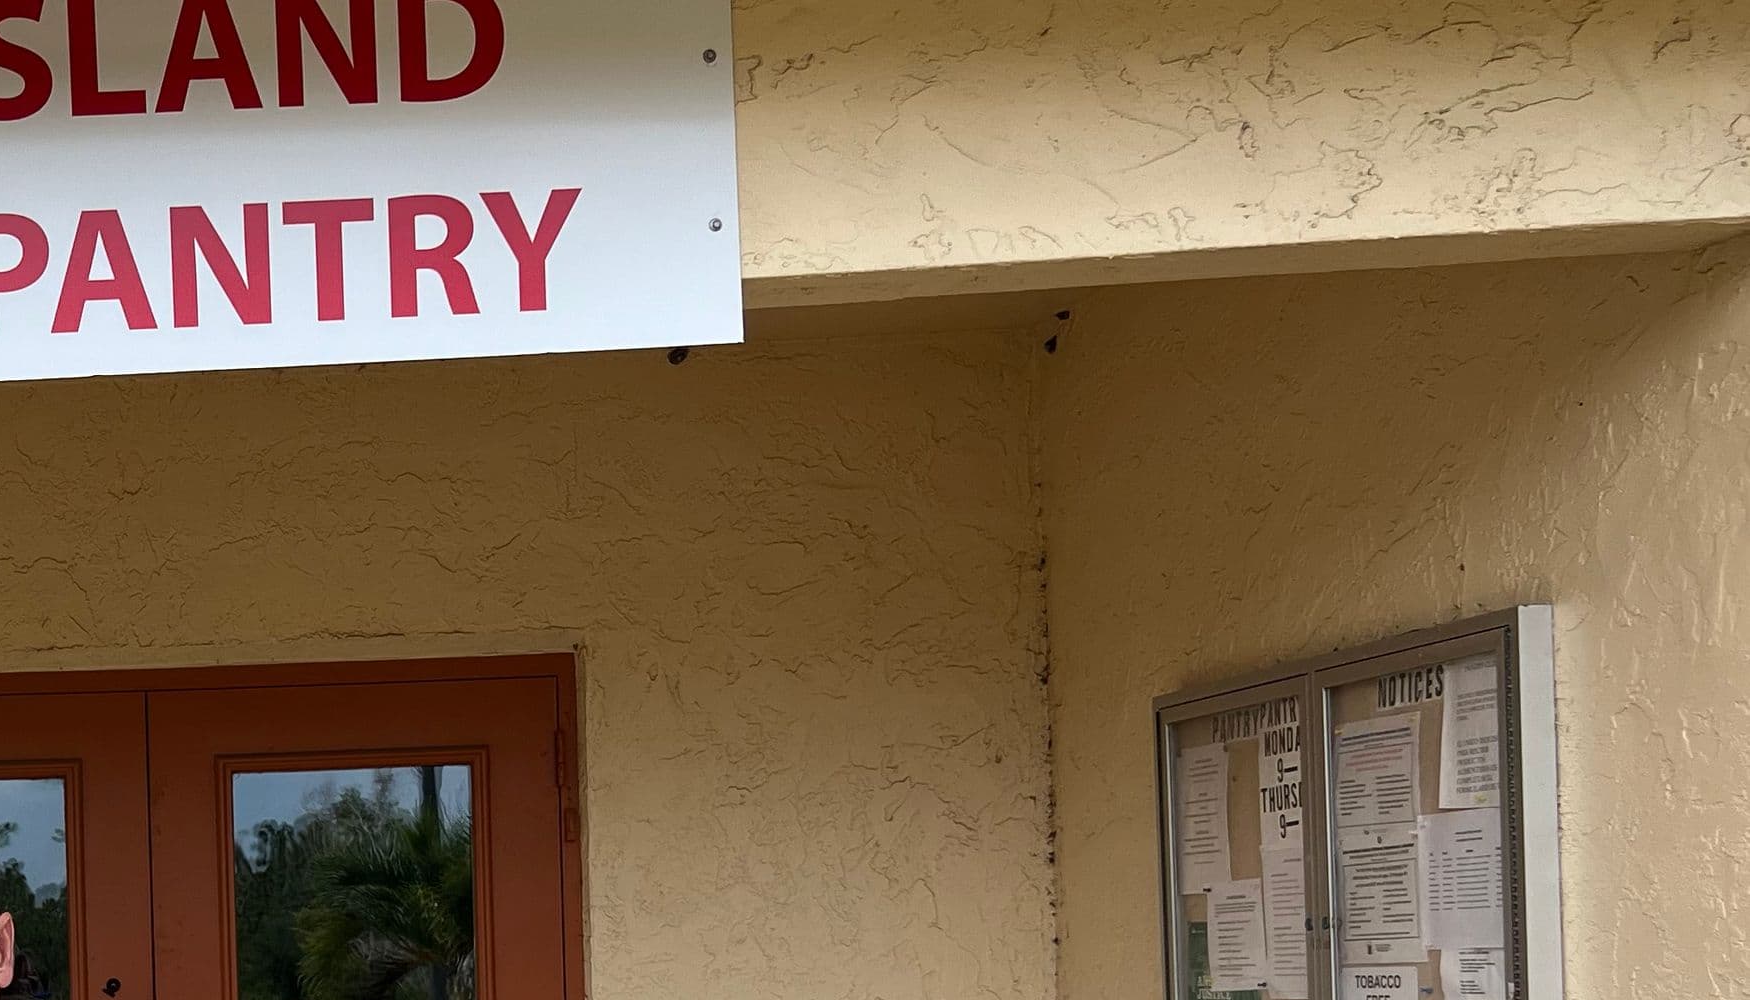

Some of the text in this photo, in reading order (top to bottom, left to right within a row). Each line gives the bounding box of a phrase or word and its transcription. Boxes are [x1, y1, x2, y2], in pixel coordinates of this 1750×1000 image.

[1377, 664, 1444, 708] NOTICES
[1211, 708, 1260, 743] PANTRY
[1259, 696, 1299, 729] PANTR
[1355, 974, 1402, 989] TOBACCO
